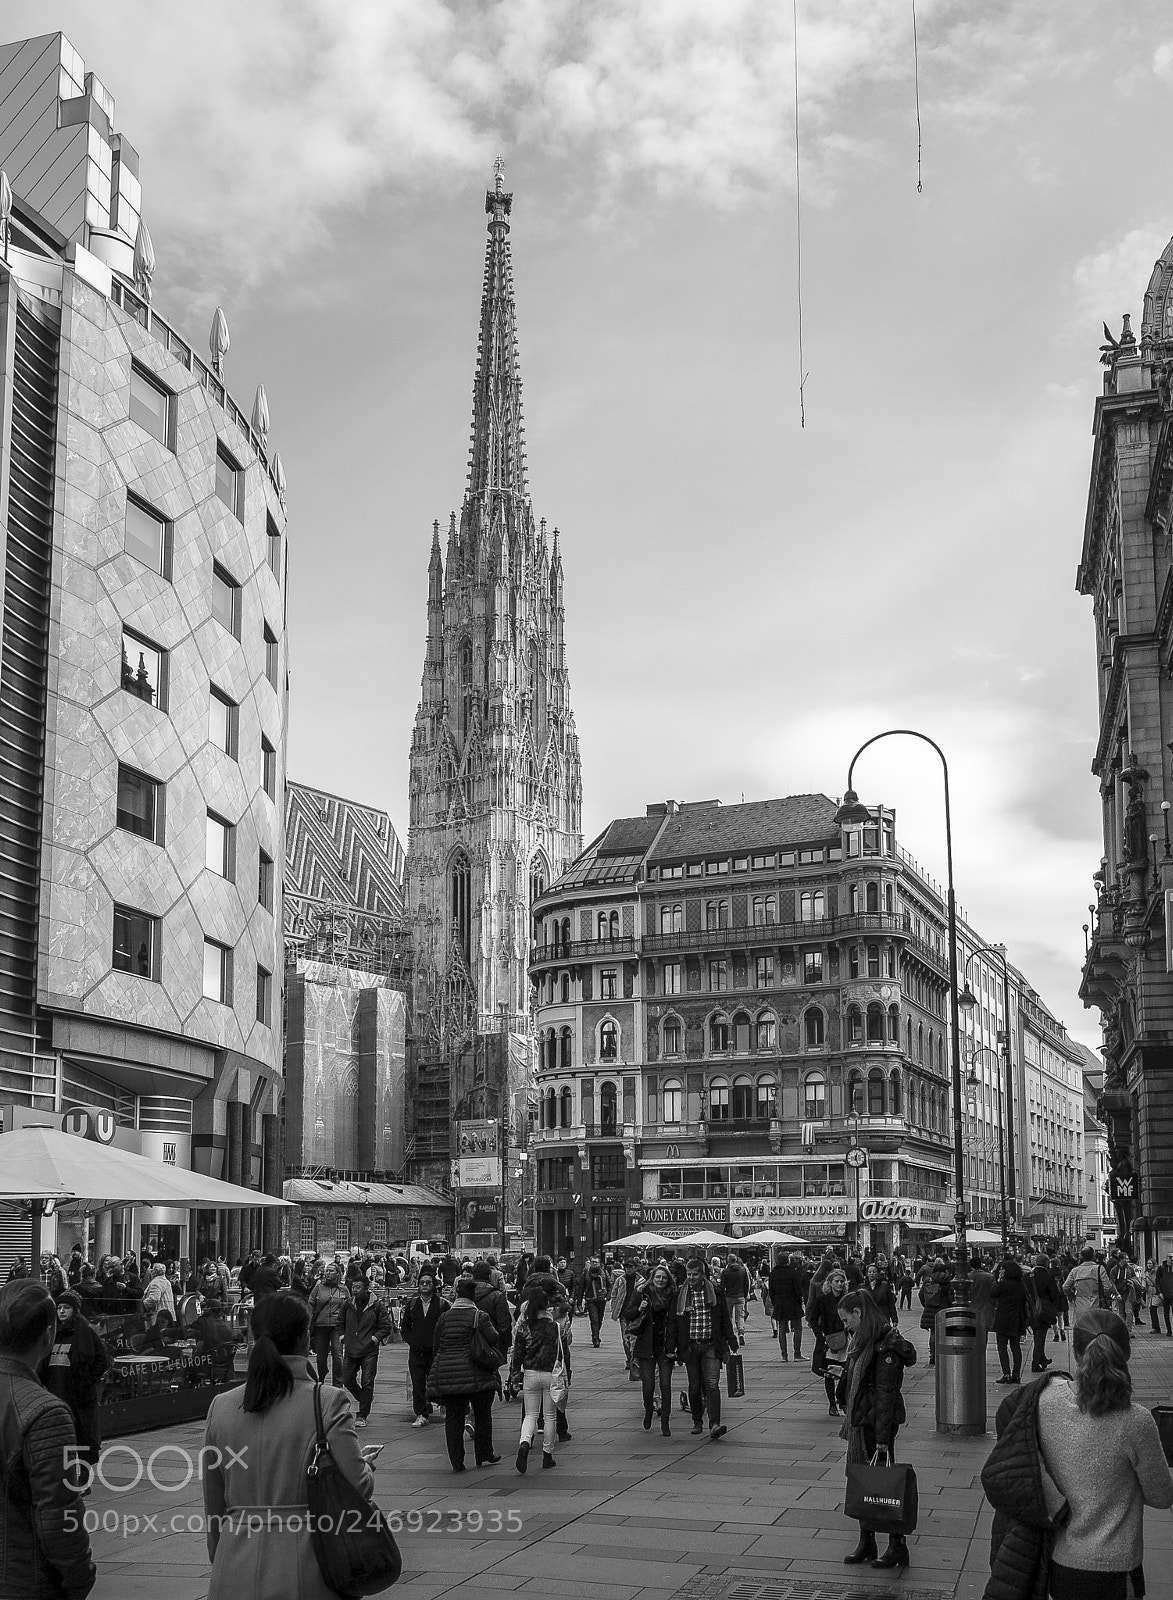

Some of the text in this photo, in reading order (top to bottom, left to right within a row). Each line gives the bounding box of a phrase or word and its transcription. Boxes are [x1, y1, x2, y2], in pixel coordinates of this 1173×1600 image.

[98, 1114, 114, 1141] U
[643, 1208, 674, 1221] MONEY
[677, 1208, 726, 1221] EXCHANGE
[121, 1363, 148, 1377] CAFE
[151, 1361, 164, 1373] DE
